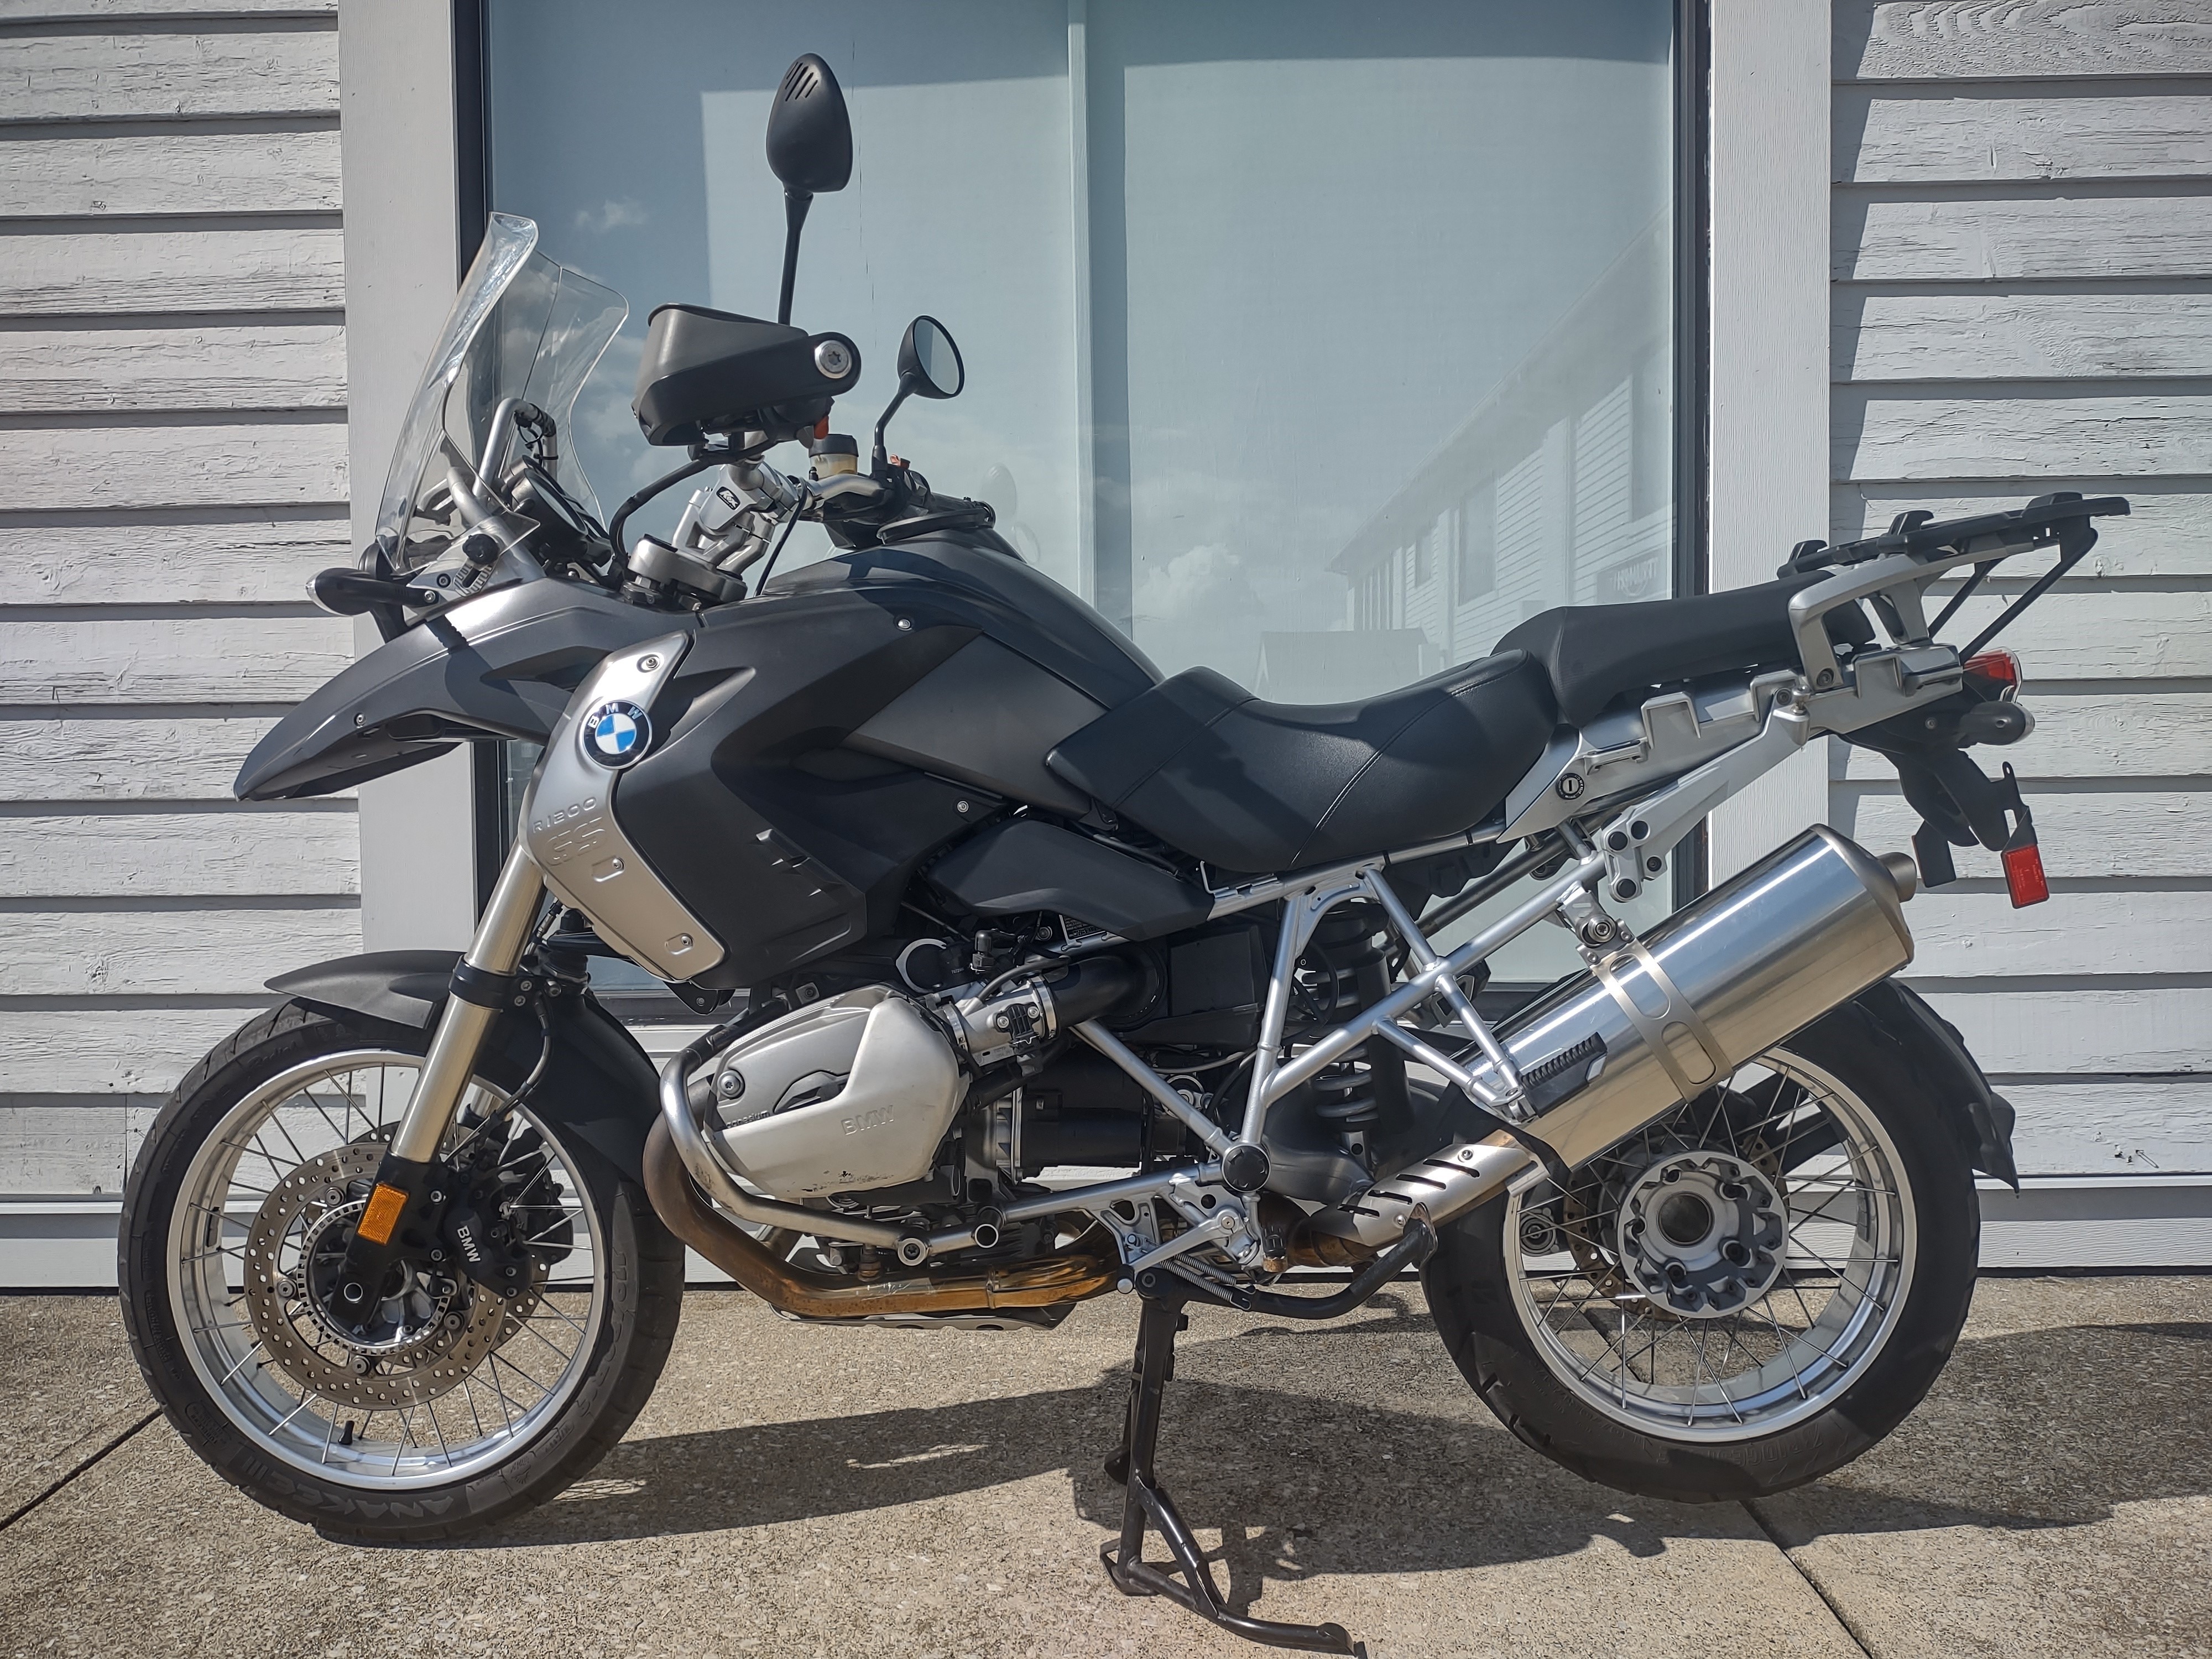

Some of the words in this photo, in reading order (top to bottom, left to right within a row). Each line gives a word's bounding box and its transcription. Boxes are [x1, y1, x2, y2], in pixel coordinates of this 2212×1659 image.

[588, 703, 643, 728] BMW
[533, 797, 596, 833] R1200
[545, 817, 606, 866] GS
[841, 1105, 894, 1135] BMW
[457, 1225, 481, 1262] BMW
[267, 1471, 453, 1519] ANAKEE
